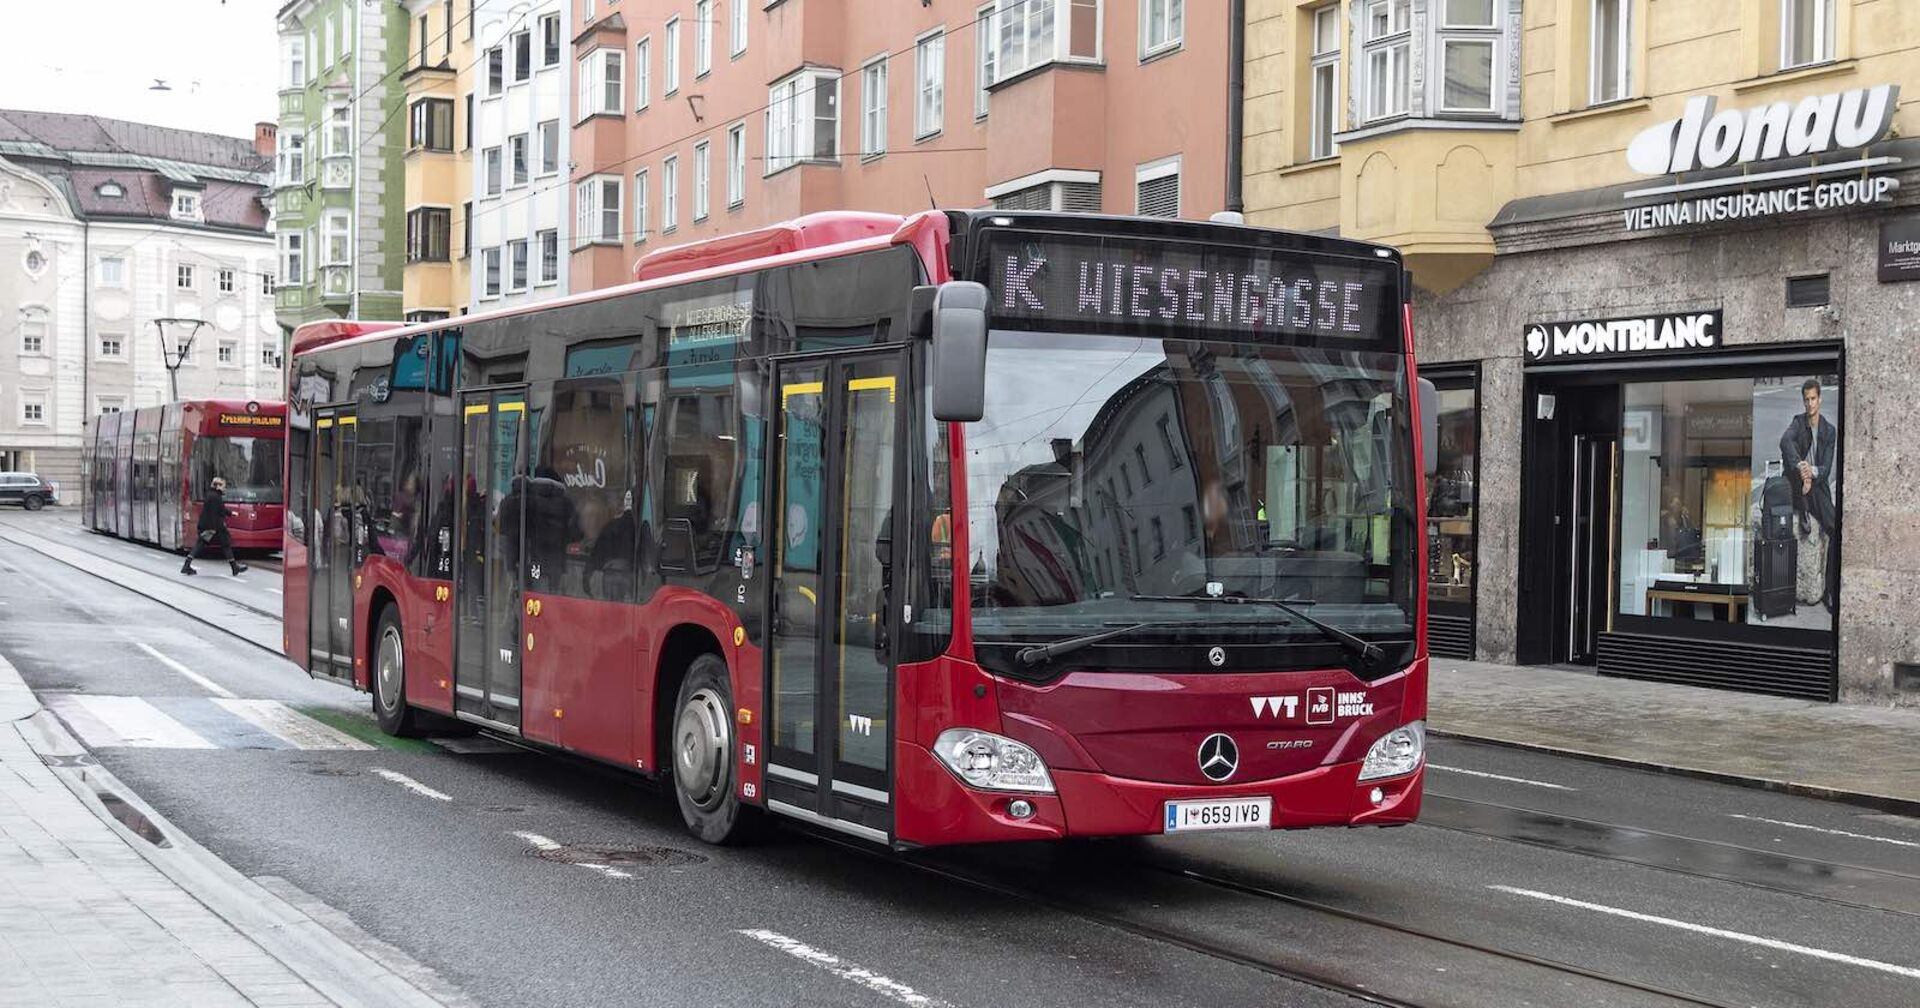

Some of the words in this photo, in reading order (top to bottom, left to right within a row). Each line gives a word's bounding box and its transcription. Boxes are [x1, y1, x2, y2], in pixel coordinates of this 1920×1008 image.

[1626, 85, 1897, 175] donau
[1624, 202, 1692, 231] VIENNA
[1696, 187, 1810, 222] INSURANCE
[1815, 177, 1892, 208] GROUP
[1004, 255, 1046, 310] K
[1078, 260, 1363, 332] WIESENGASSE
[1553, 315, 1715, 355] MONTBLANC
[849, 714, 872, 736] VVT
[1249, 696, 1299, 719] VVT
[1337, 703, 1374, 717] BRUCK
